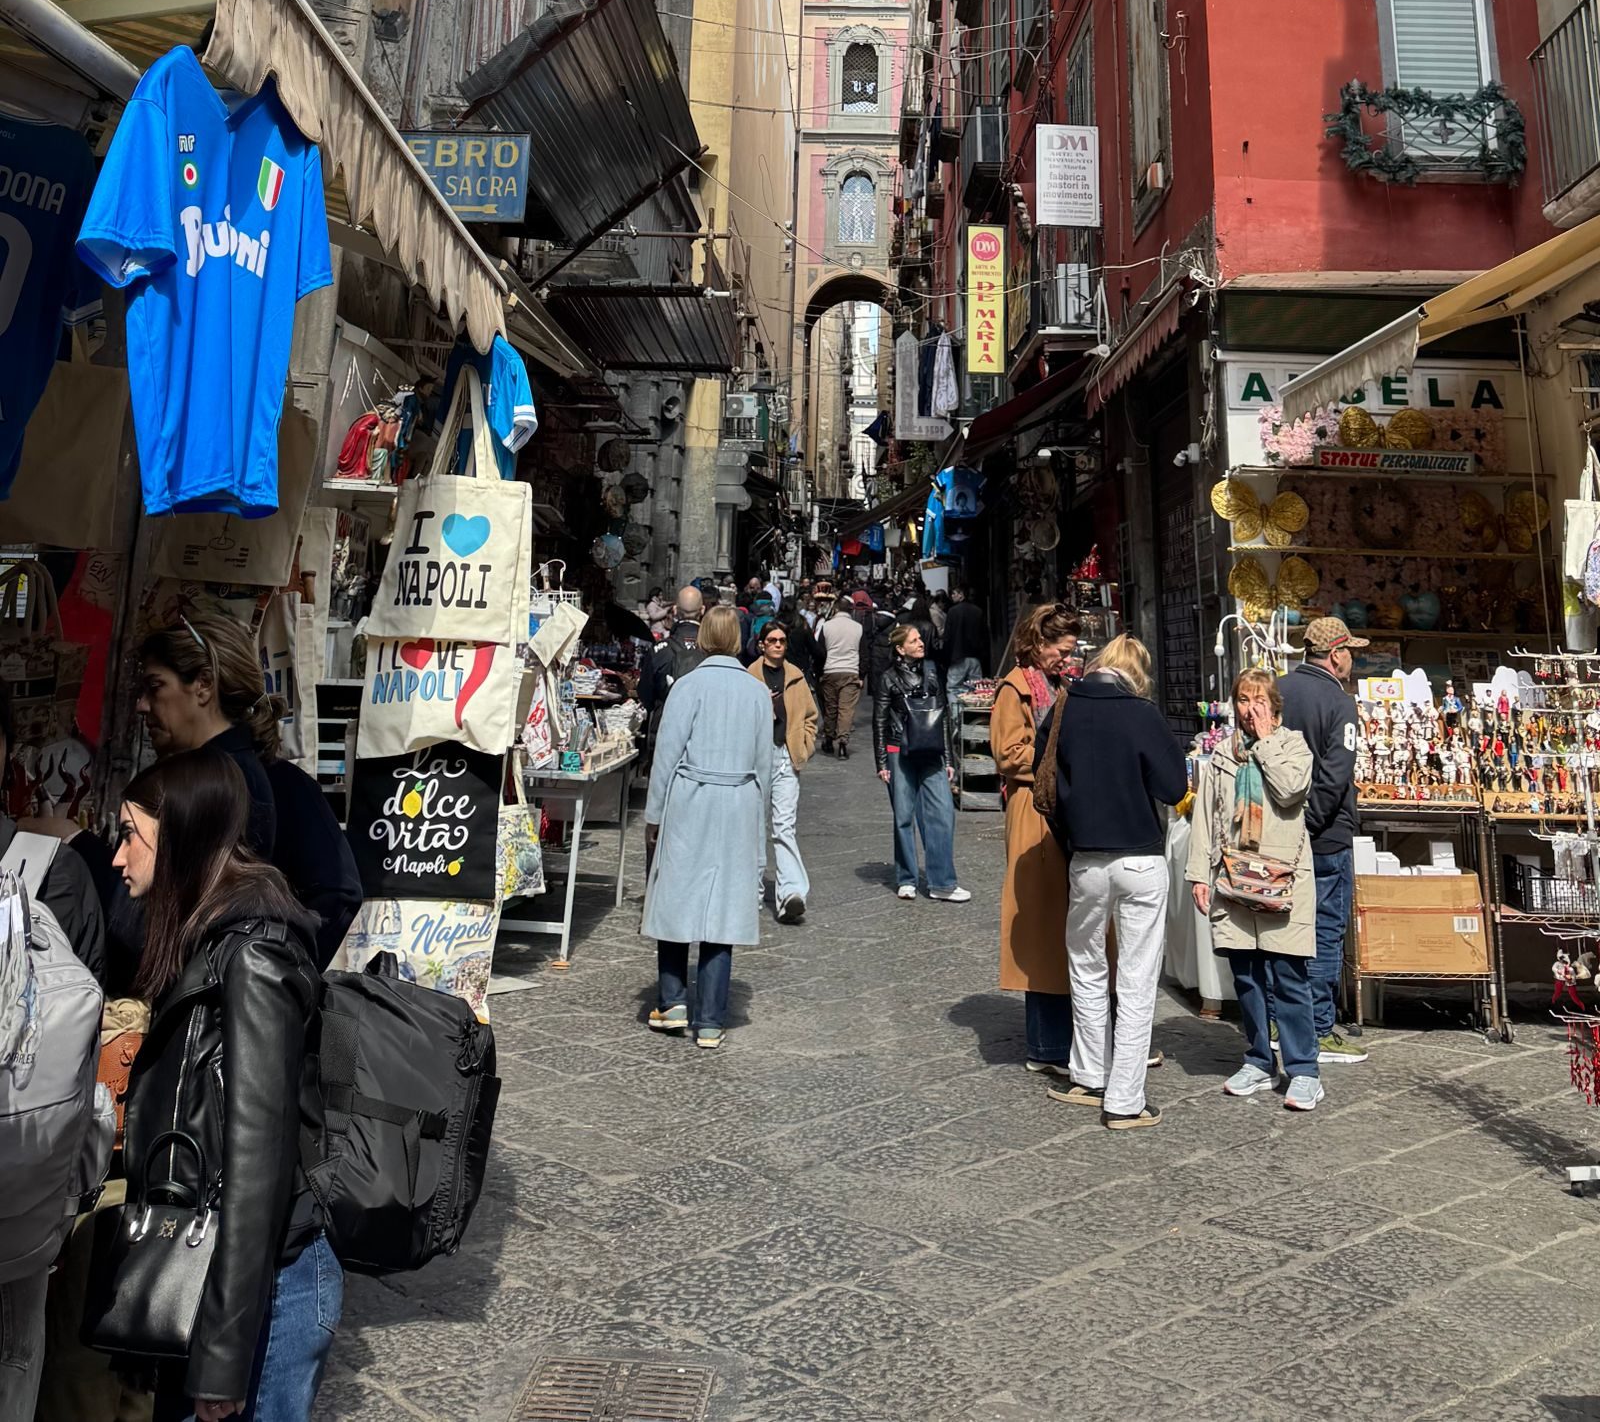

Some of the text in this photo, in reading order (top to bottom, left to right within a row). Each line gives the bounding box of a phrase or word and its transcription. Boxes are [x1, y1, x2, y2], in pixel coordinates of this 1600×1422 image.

[1047, 134, 1088, 151] DM
[445, 175, 518, 198] SACRA
[1047, 181, 1090, 191] pastori in
[1049, 172, 1087, 182] fabbrica
[1042, 190, 1093, 200] movimento
[975, 240, 996, 253] DM
[975, 281, 996, 364] DE MARIA
[1320, 451, 1470, 473] STATUE PERSONALIZZATE
[405, 511, 435, 554] I
[394, 560, 491, 609] NAPOLI
[372, 669, 464, 705] NAPOLI
[1344, 722, 1357, 752] 8
[392, 746, 468, 779] La
[368, 818, 470, 853] Vita
[383, 854, 449, 878] Napoli
[411, 912, 494, 956] Napoli
